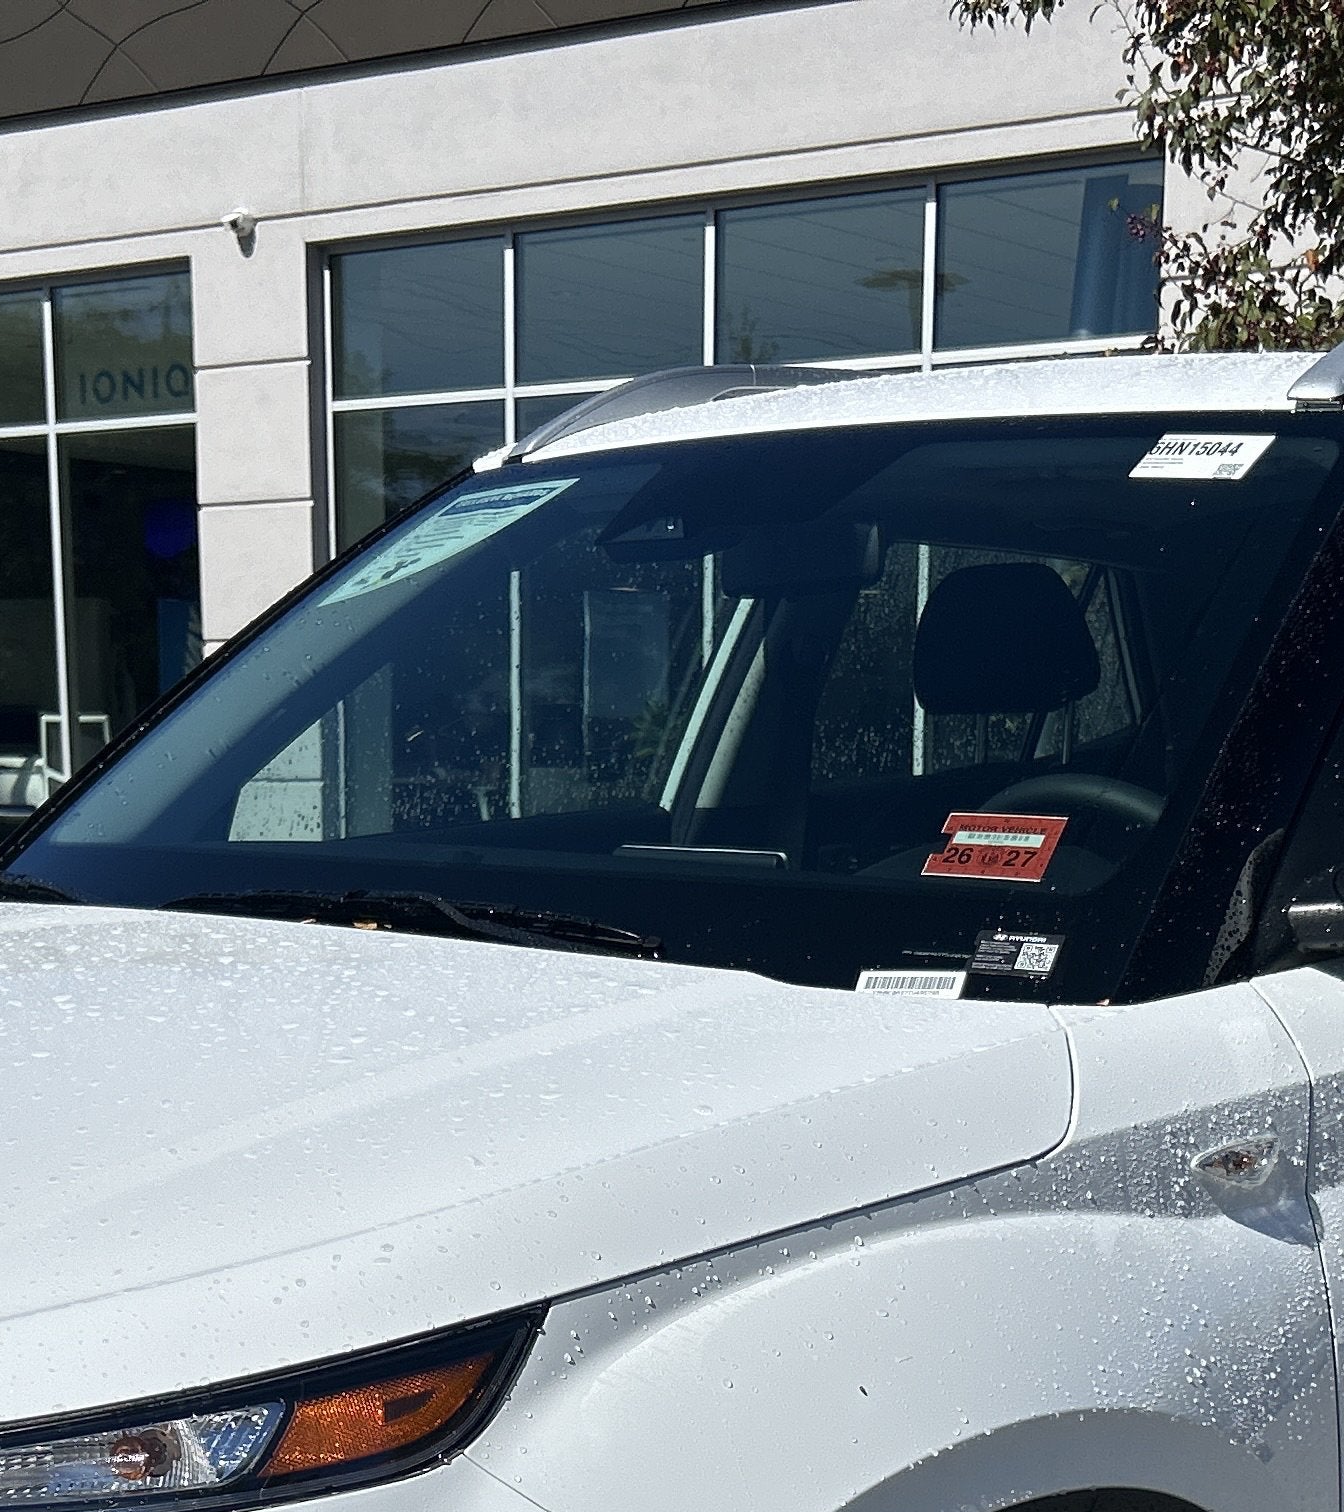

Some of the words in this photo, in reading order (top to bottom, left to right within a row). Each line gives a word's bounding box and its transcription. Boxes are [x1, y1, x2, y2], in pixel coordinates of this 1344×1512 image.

[958, 823, 998, 834] MOTOR
[1001, 825, 1047, 835] VEHICLE
[942, 846, 974, 865] 26
[1001, 849, 1038, 868] 27
